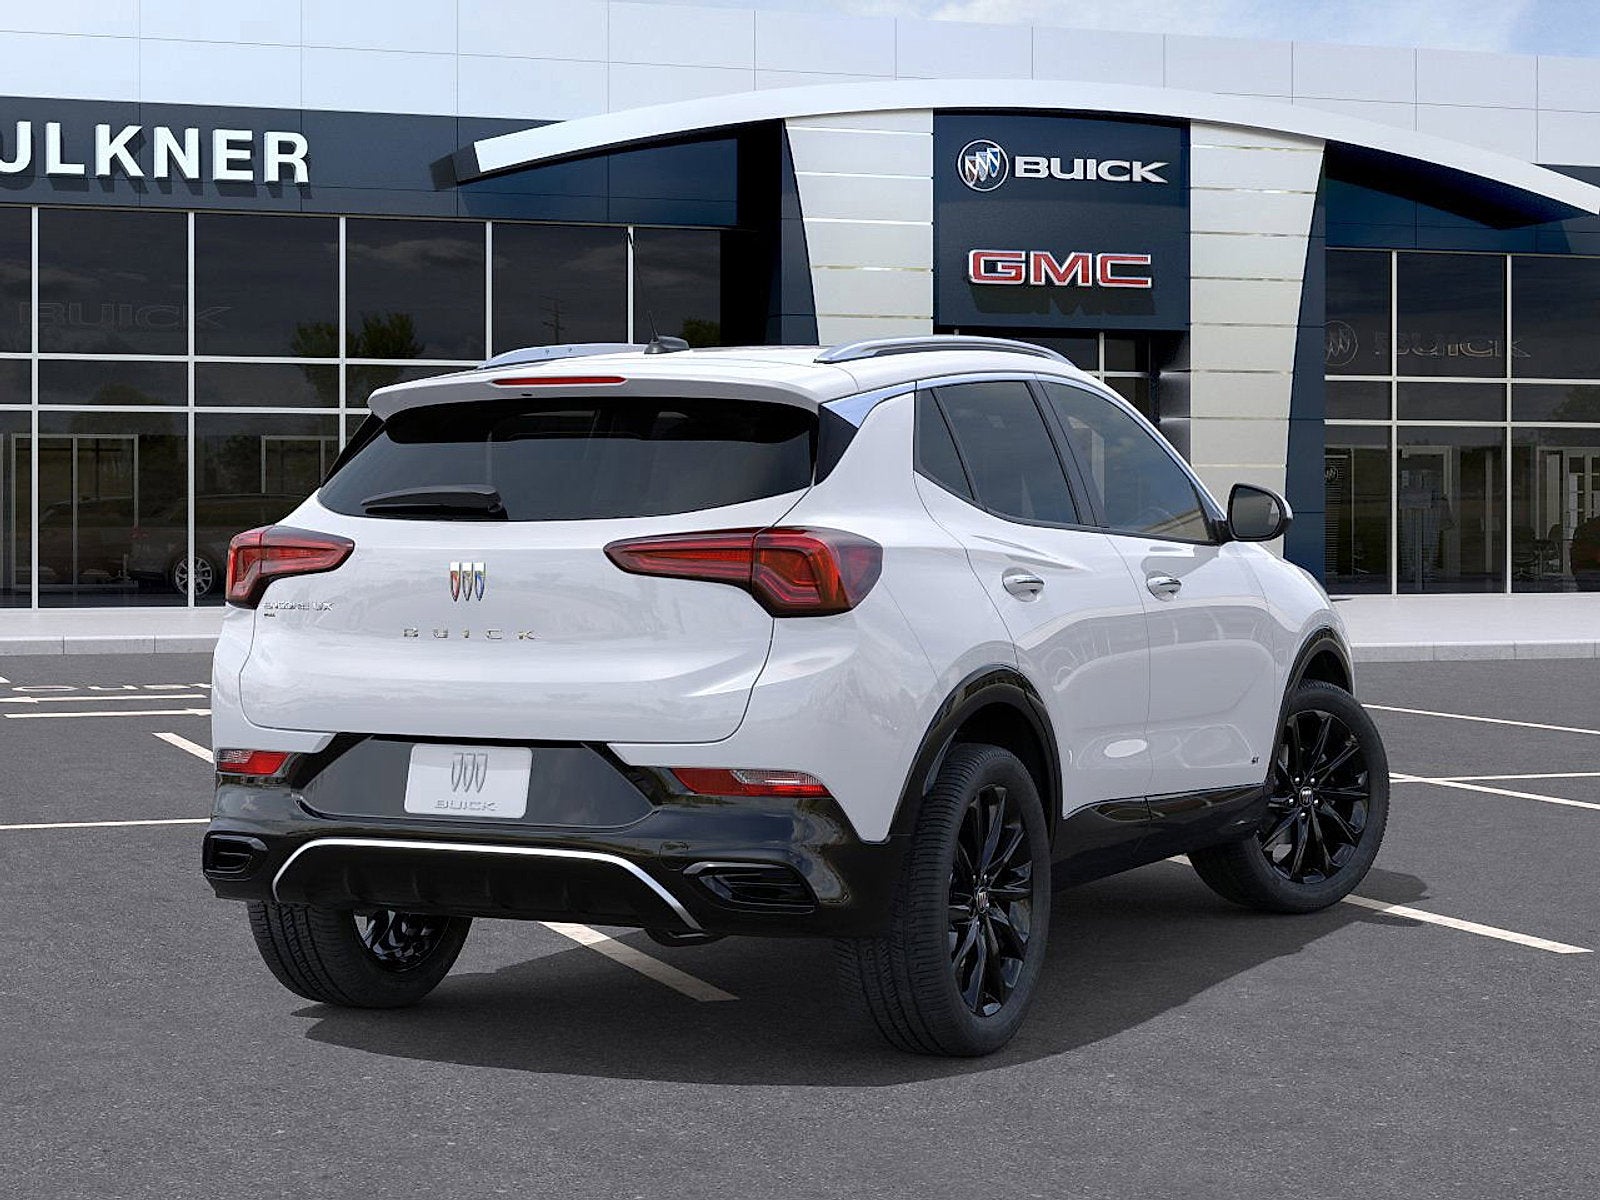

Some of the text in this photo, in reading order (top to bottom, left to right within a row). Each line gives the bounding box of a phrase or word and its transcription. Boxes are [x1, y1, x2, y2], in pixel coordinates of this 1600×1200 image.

[1014, 155, 1170, 184] BUICK
[968, 248, 1152, 289] GMC
[403, 628, 536, 640] BUICK
[434, 799, 499, 812] BUICK
